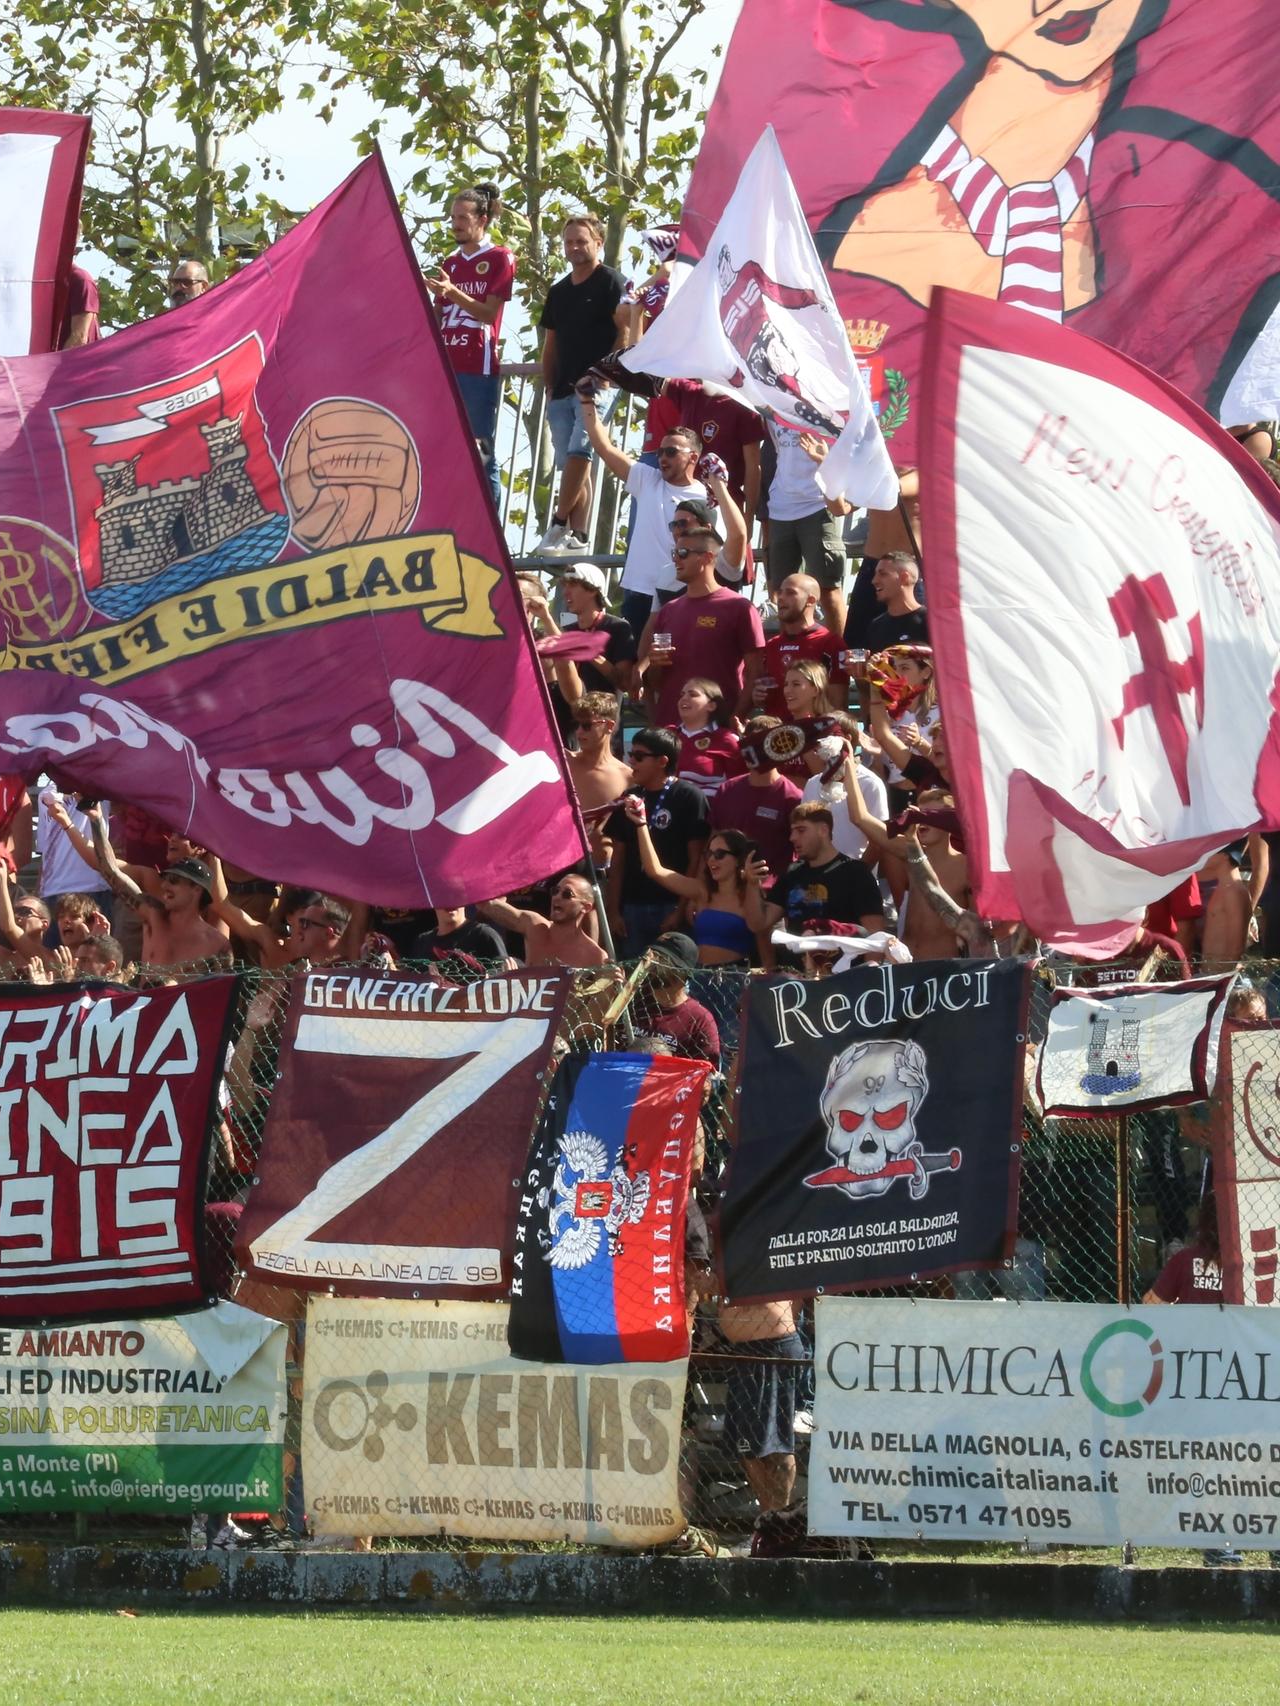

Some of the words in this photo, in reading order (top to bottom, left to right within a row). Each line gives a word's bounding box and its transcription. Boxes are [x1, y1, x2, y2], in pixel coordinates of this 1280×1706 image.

[304, 974, 561, 1015] GENERAZIONE
[770, 963, 996, 1050] Reduci
[249, 1014, 551, 1286] Z
[769, 1232, 806, 1250] NELLA
[806, 1226, 847, 1245] FORZA
[849, 1224, 865, 1240] LA
[866, 1220, 898, 1237] SOLA
[769, 1253, 795, 1269] FINE
[797, 1252, 806, 1266] E
[806, 1245, 856, 1265] PREMIO
[856, 1238, 916, 1259] SOLTANTO
[918, 1229, 958, 1251] L'ONOR!
[256, 1251, 310, 1273] FEDELI
[314, 1259, 366, 1278] ALLA
[370, 1262, 423, 1281] LINEA
[428, 1266, 458, 1282] DEL
[1192, 1257, 1224, 1278] BA
[17, 1330, 145, 1357] AMIANTO
[335, 1319, 384, 1340] KEMAS
[409, 1320, 459, 1341] KEMAS
[20, 1369, 53, 1394] ED
[827, 1341, 1075, 1397] CHIMICA
[63, 1405, 271, 1433] POLIURETANICA
[425, 1372, 674, 1475] KEMAS
[828, 1431, 865, 1450] VIA
[871, 1432, 938, 1454] DELLA
[945, 1434, 1071, 1461] MAGNOLIA,
[1079, 1438, 1091, 1458] 6
[1099, 1439, 1262, 1462] CASTELFRANCO
[2, 1459, 13, 1472] a
[17, 1454, 81, 1473] Monte
[85, 1452, 119, 1475] (PI)
[829, 1465, 1119, 1493] www.chimicaitaliana.it
[71, 1479, 270, 1503] info@pierigegroup.it
[333, 1496, 380, 1515] KEMAS
[408, 1496, 460, 1516] KEMAS
[484, 1499, 535, 1520] KEMAS
[562, 1503, 603, 1523] KEMAS
[623, 1506, 675, 1527] KEMAS
[842, 1500, 899, 1522] TEL.
[907, 1503, 967, 1524] 0571
[978, 1506, 1071, 1529] 471095
[1178, 1511, 1225, 1533] FAX
